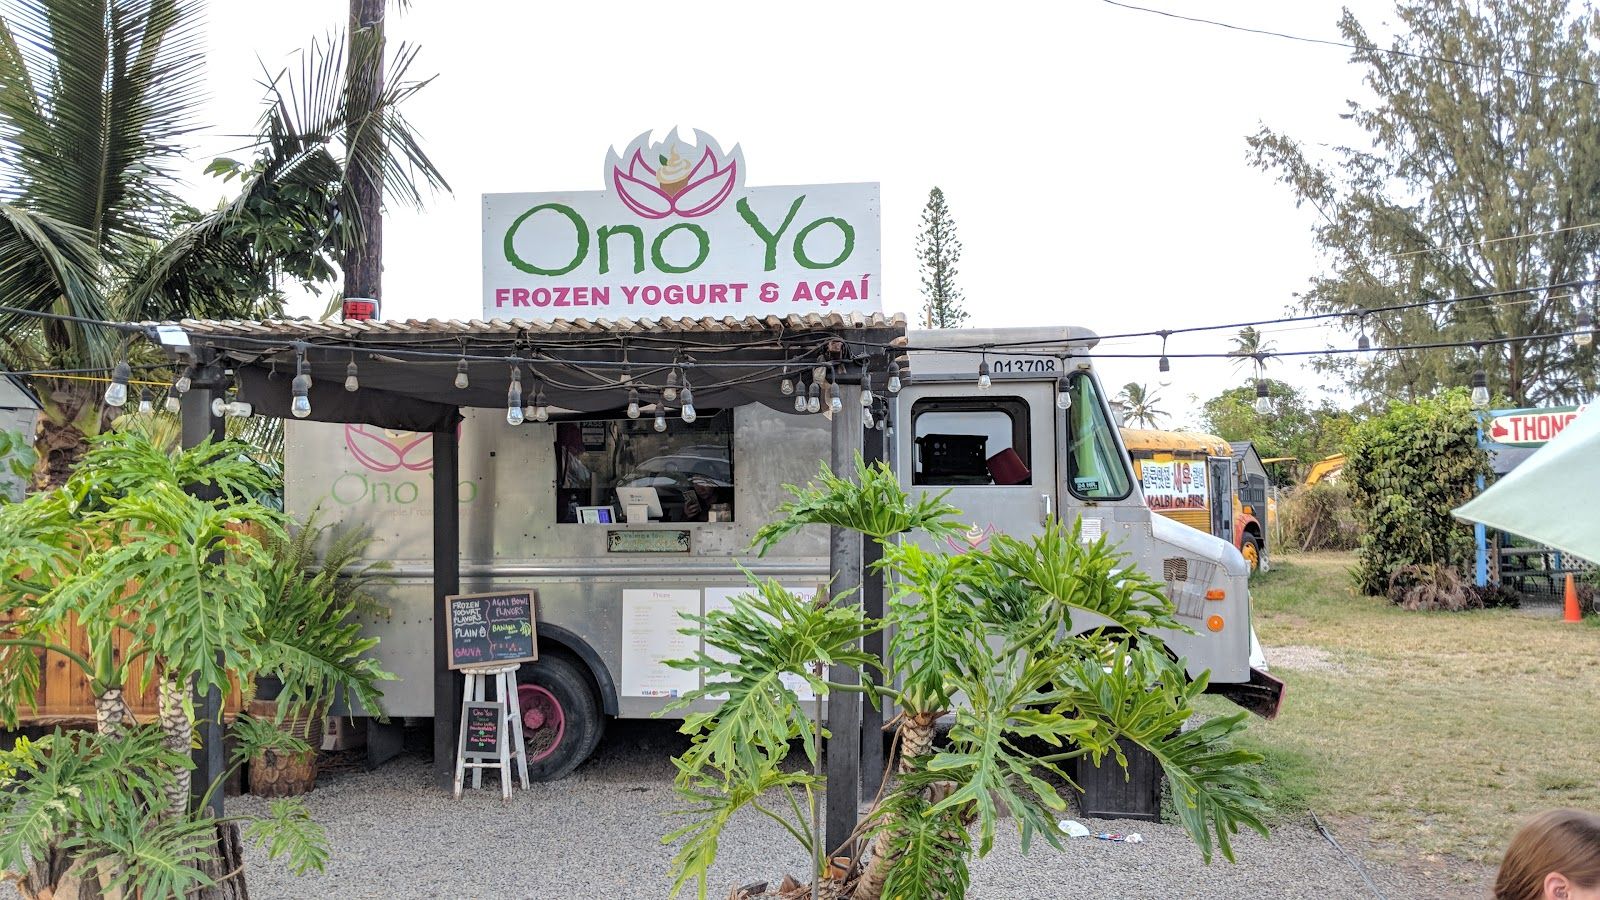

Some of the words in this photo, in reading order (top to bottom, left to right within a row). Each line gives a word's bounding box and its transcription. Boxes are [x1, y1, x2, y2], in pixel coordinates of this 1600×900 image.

[504, 203, 710, 276] Ono
[736, 194, 855, 271] Yo
[496, 286, 610, 307] FROZEN
[621, 283, 748, 306] YOGURT
[759, 281, 779, 303] &
[792, 273, 870, 307] AÇAÍ
[994, 360, 1055, 372] 013708
[332, 473, 418, 504] Ono
[1148, 494, 1173, 508] KALBI
[453, 601, 480, 610] FROZEN
[511, 596, 529, 605] BOWL
[495, 606, 524, 617] FLAVORS
[453, 614, 482, 624] FLAVORS
[455, 628, 477, 639] PLAIN
